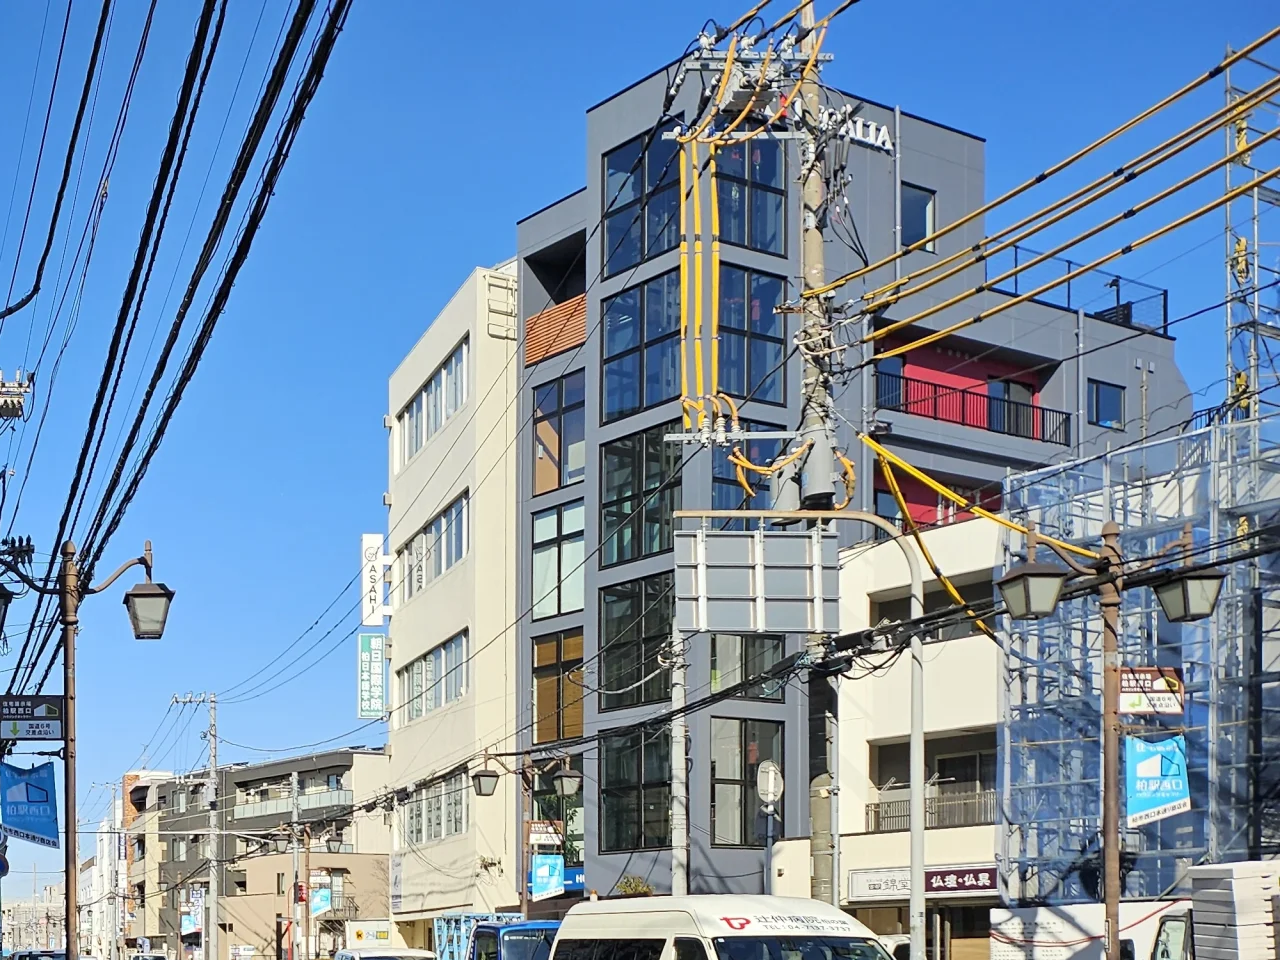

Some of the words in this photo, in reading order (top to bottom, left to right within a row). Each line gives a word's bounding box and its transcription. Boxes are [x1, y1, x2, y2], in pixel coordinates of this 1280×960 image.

[368, 564, 378, 614] ASAHI
[2, 707, 32, 715] 柏駅西口
[930, 872, 991, 888] 仏壇・仏具
